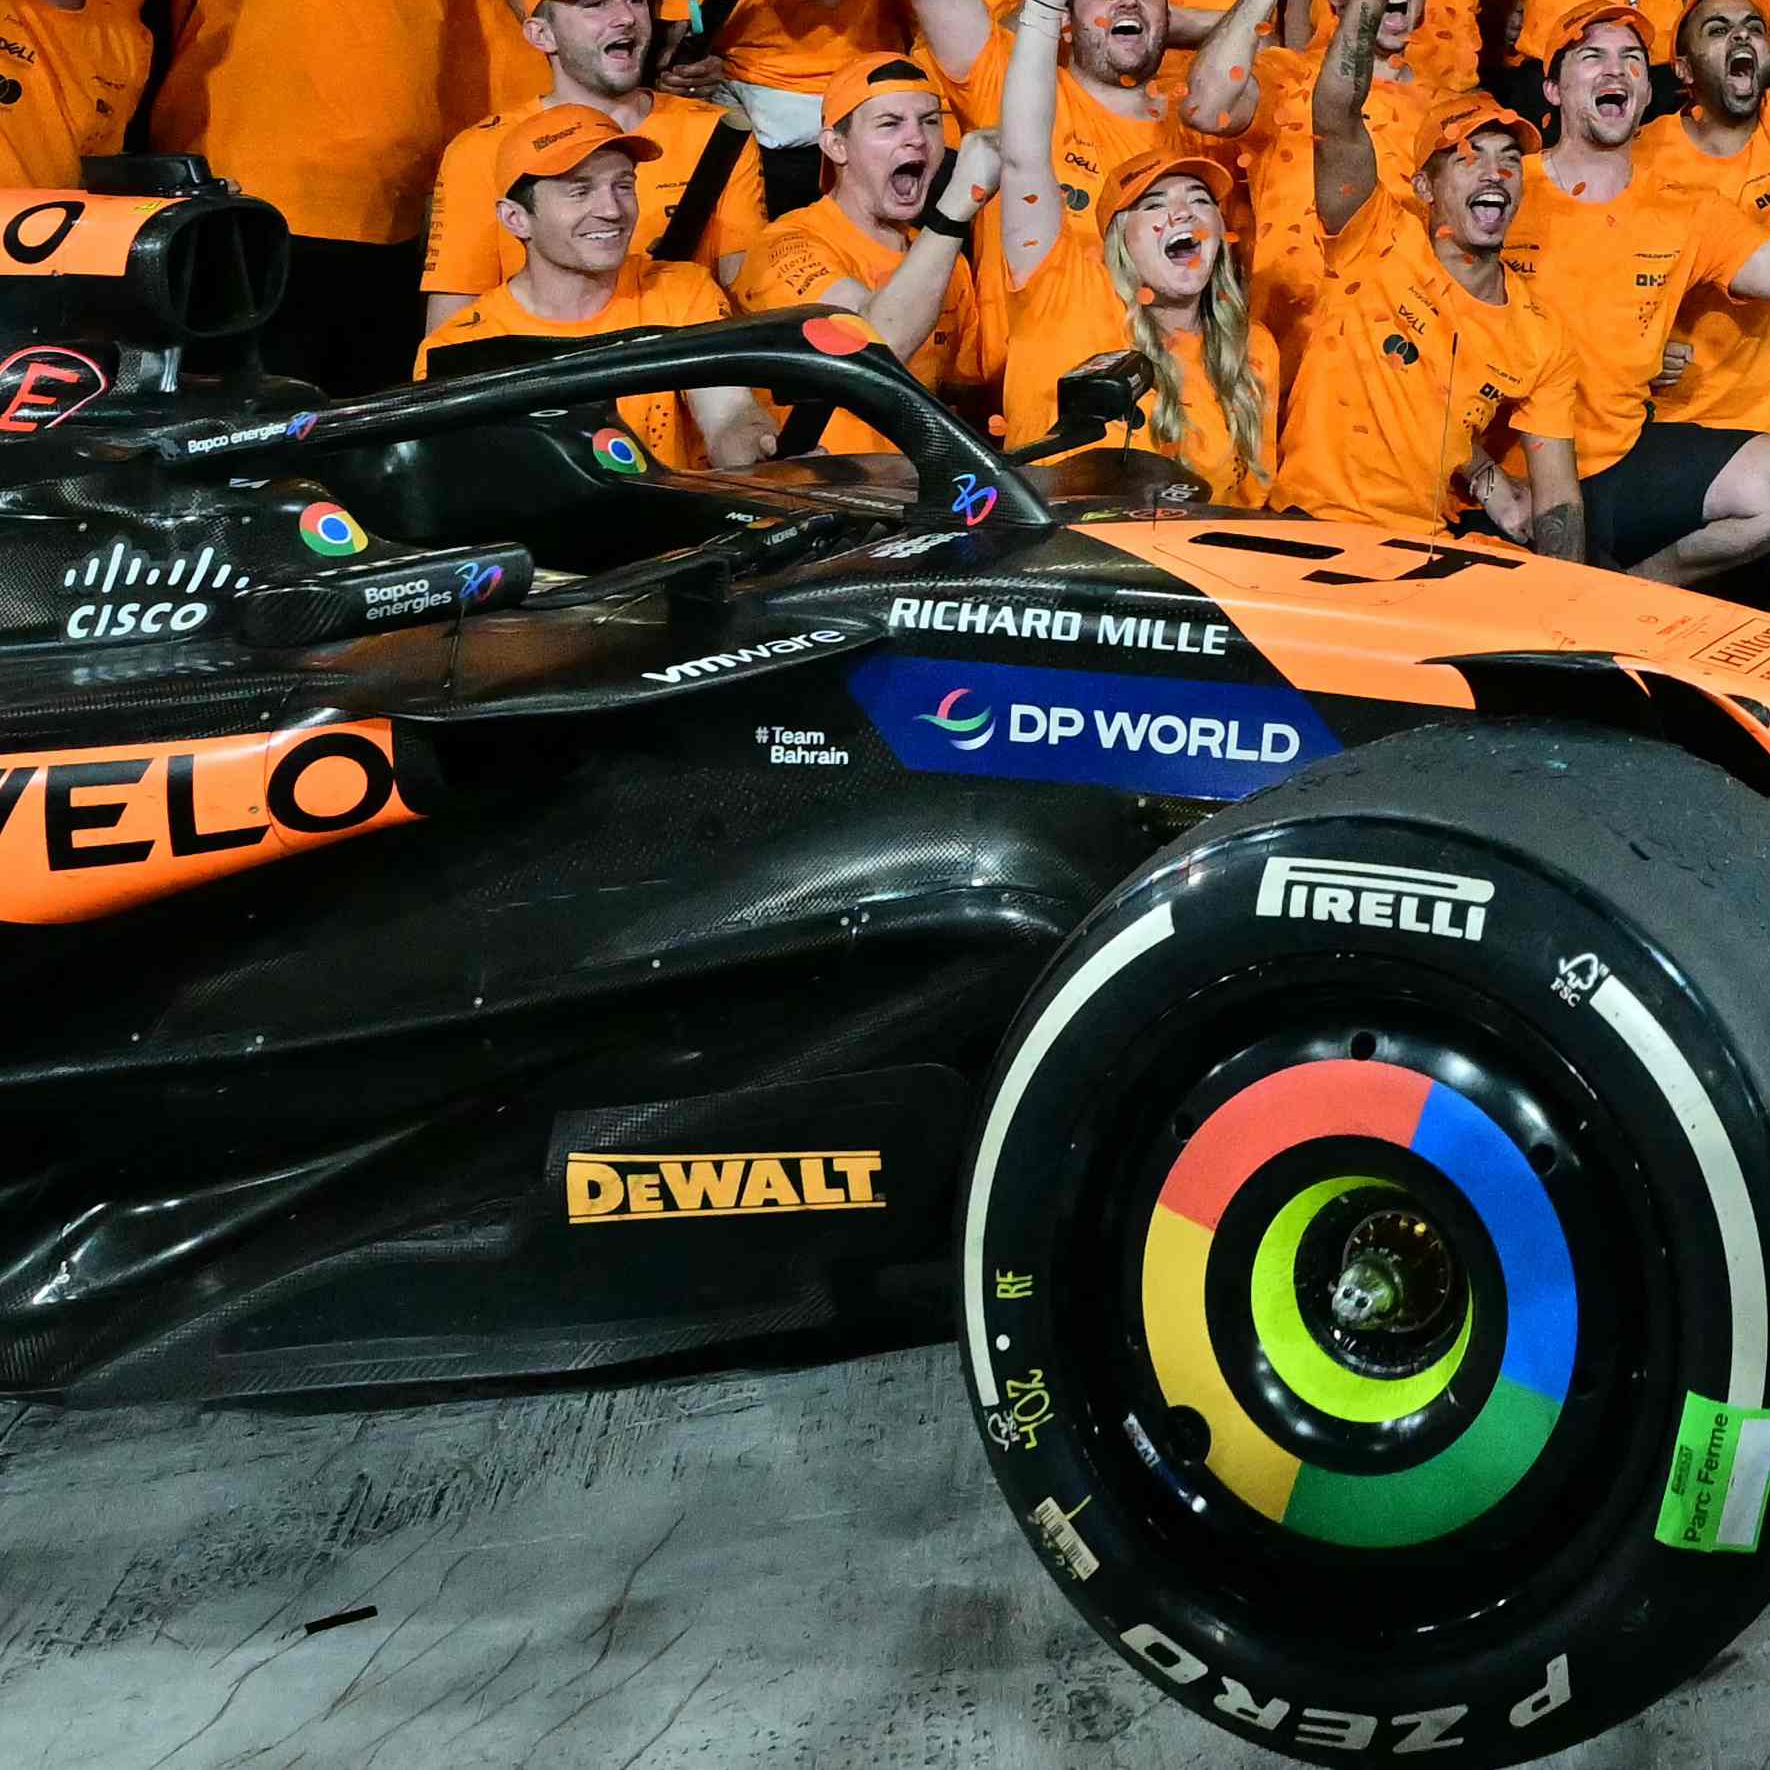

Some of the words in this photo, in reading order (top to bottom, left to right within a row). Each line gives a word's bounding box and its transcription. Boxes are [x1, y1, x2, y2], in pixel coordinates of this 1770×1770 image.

[1064, 152, 1099, 175] DELL
[187, 431, 229, 455] Bapco
[229, 422, 287, 446] energies
[364, 576, 430, 605] Bapco
[365, 590, 453, 622] energies
[887, 597, 1082, 644] RICHARD
[1096, 615, 1230, 657] MILLE
[640, 630, 848, 687] vmware
[769, 745, 849, 766] Bahrain
[771, 726, 826, 746] Team
[1008, 703, 1085, 747] DP
[1094, 710, 1301, 764] WORLD
[1255, 855, 1495, 942] PIRELLI
[1693, 1411, 1731, 1481] Ferme
[1682, 1483, 1714, 1546] Parc
[1117, 1621, 1470, 1754] ZERO
[1511, 1652, 1573, 1731] P
